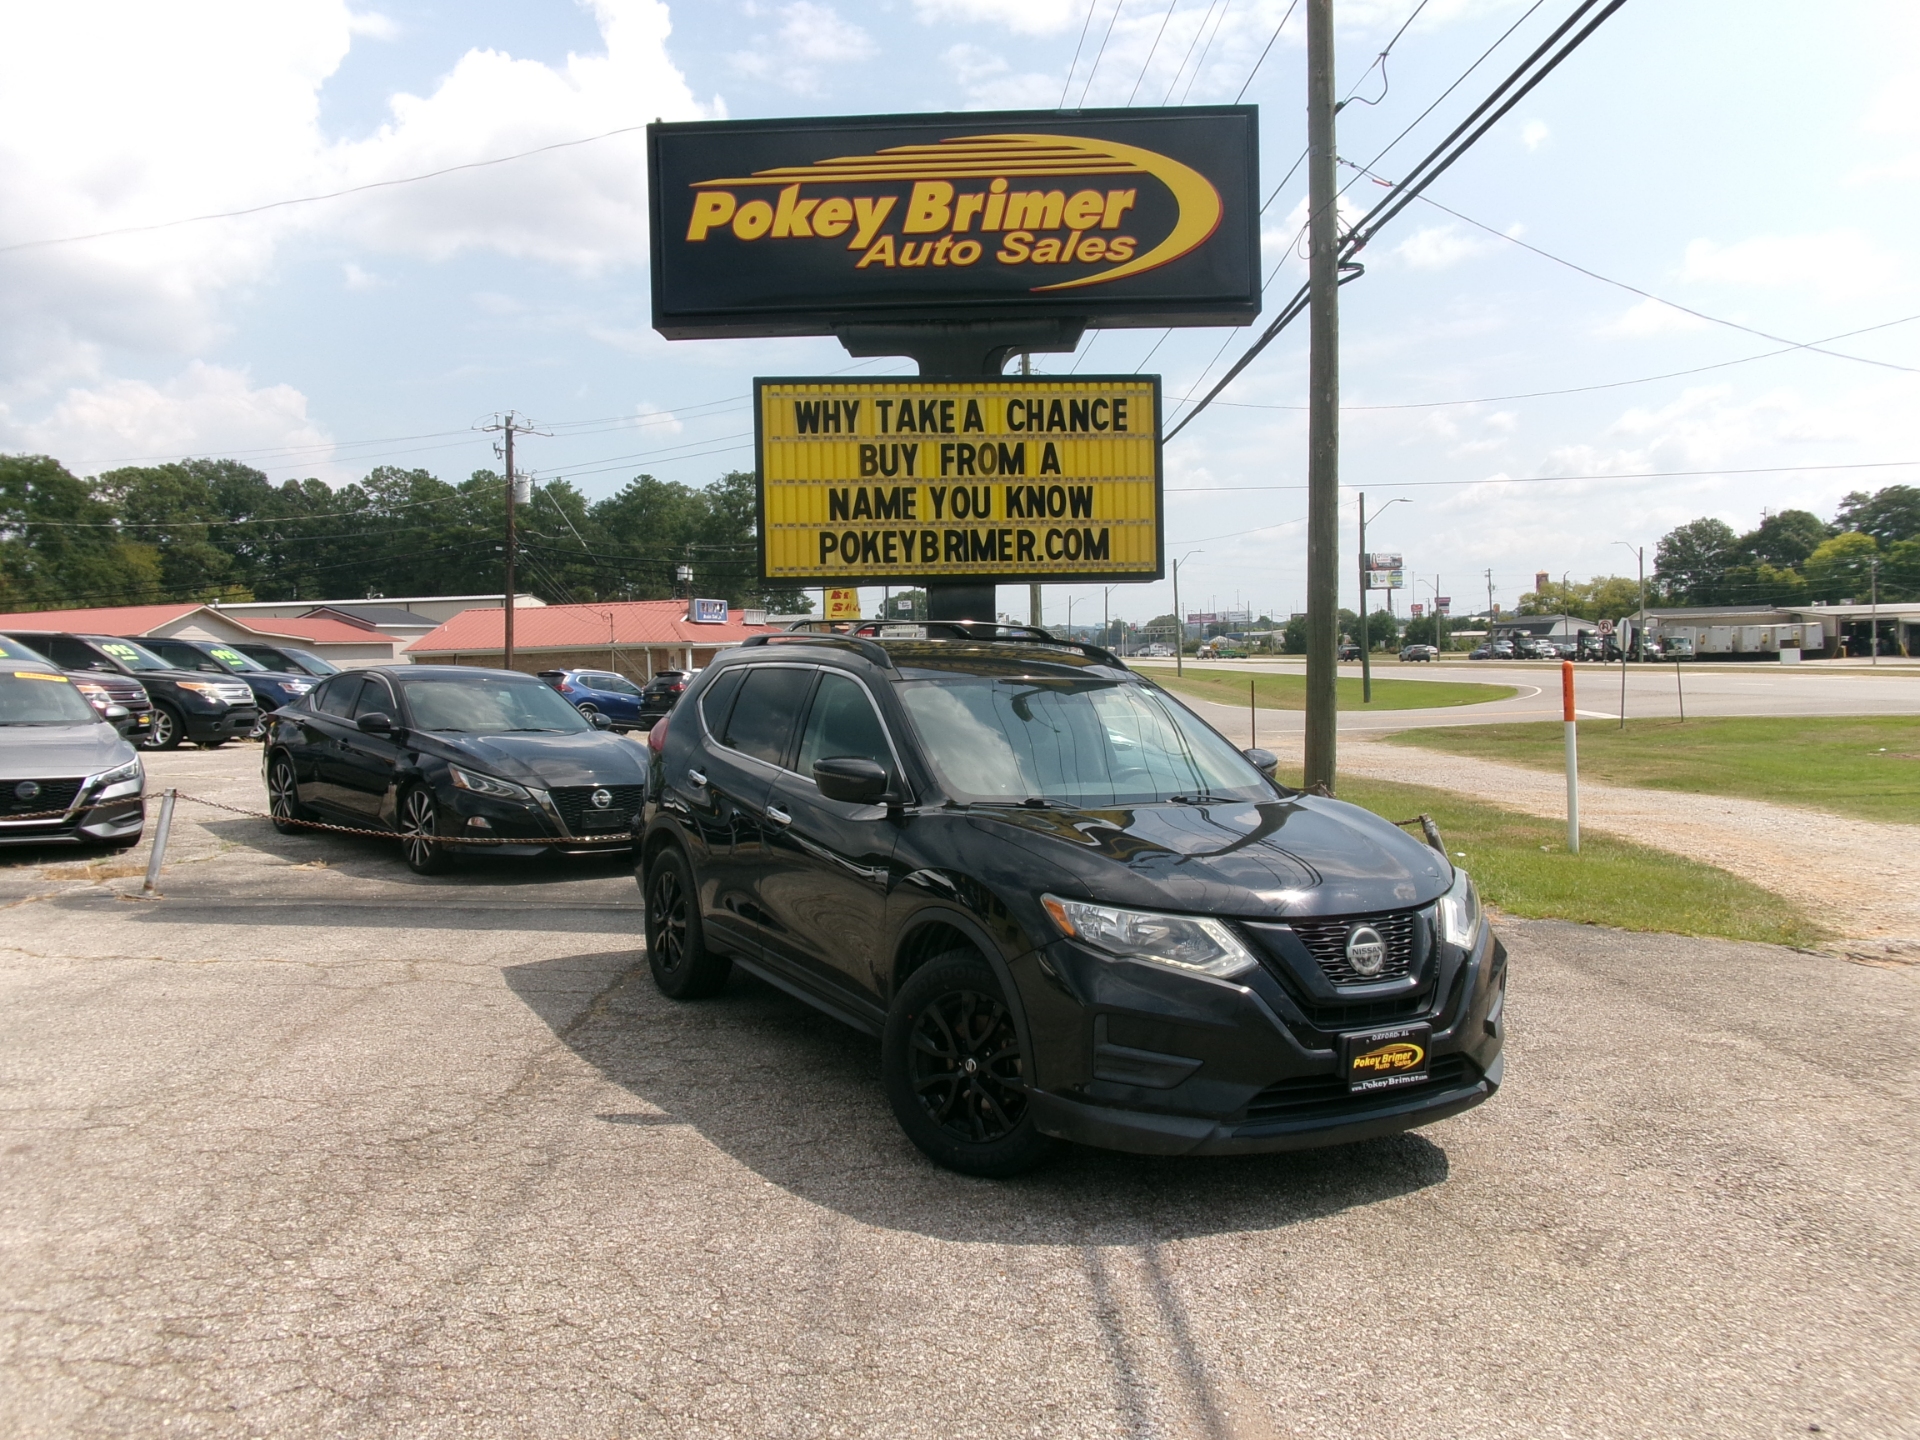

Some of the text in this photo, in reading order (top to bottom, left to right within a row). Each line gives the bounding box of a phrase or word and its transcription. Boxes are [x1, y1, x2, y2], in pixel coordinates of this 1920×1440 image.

[685, 177, 1137, 250] Pokey Brimer
[854, 230, 1138, 268] Auto Sales
[794, 398, 1128, 434] WHY TAKE A CHANCE
[859, 442, 1062, 477] BUY FROM A
[828, 485, 1093, 521] NAME YOU KNOW
[819, 528, 1110, 565] POKEYBRIMER.COM
[1352, 945, 1383, 955] NISSAN
[1353, 1051, 1412, 1069] Pokey Brimer
[1374, 1062, 1390, 1070] Auto
